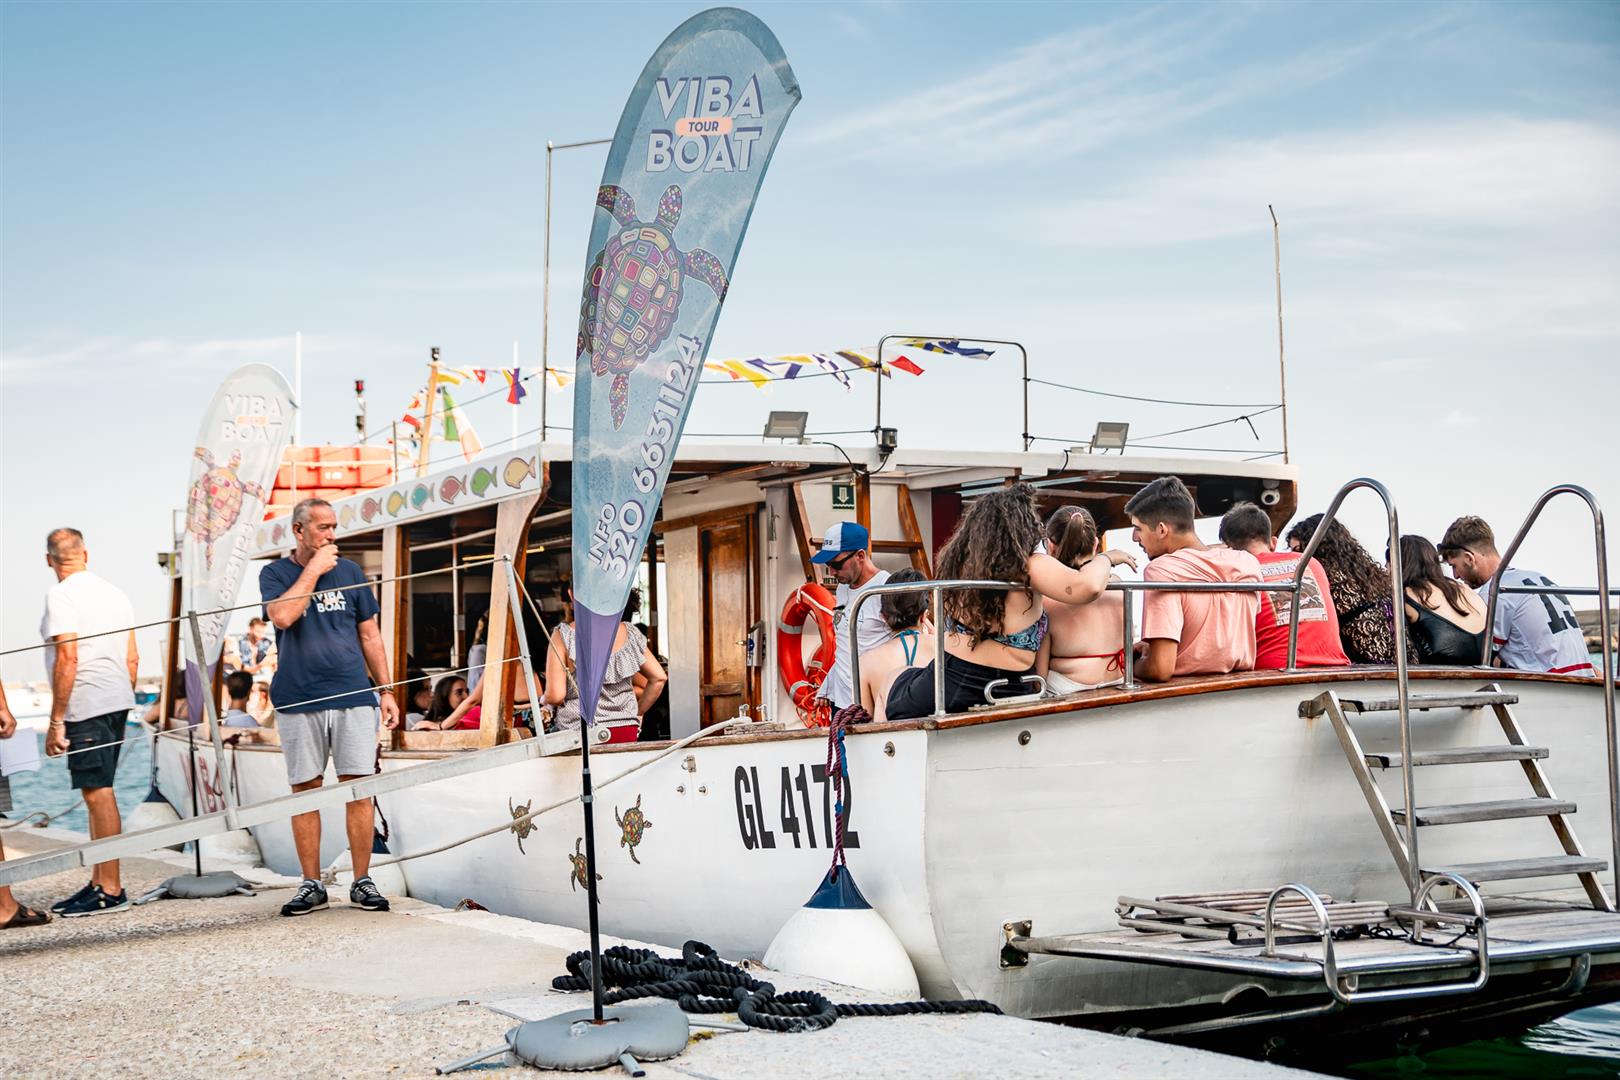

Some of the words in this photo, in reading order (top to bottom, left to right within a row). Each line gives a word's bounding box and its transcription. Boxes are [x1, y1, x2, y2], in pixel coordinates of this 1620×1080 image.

[655, 73, 764, 121] VIBA
[645, 127, 763, 173] BOAT
[688, 121, 719, 132] TOUR
[602, 499, 645, 582] 320
[632, 333, 703, 494] 6631124
[587, 502, 617, 566] INFO
[316, 601, 347, 613] BOAT
[734, 765, 776, 850] GL
[780, 763, 861, 849] 4172
